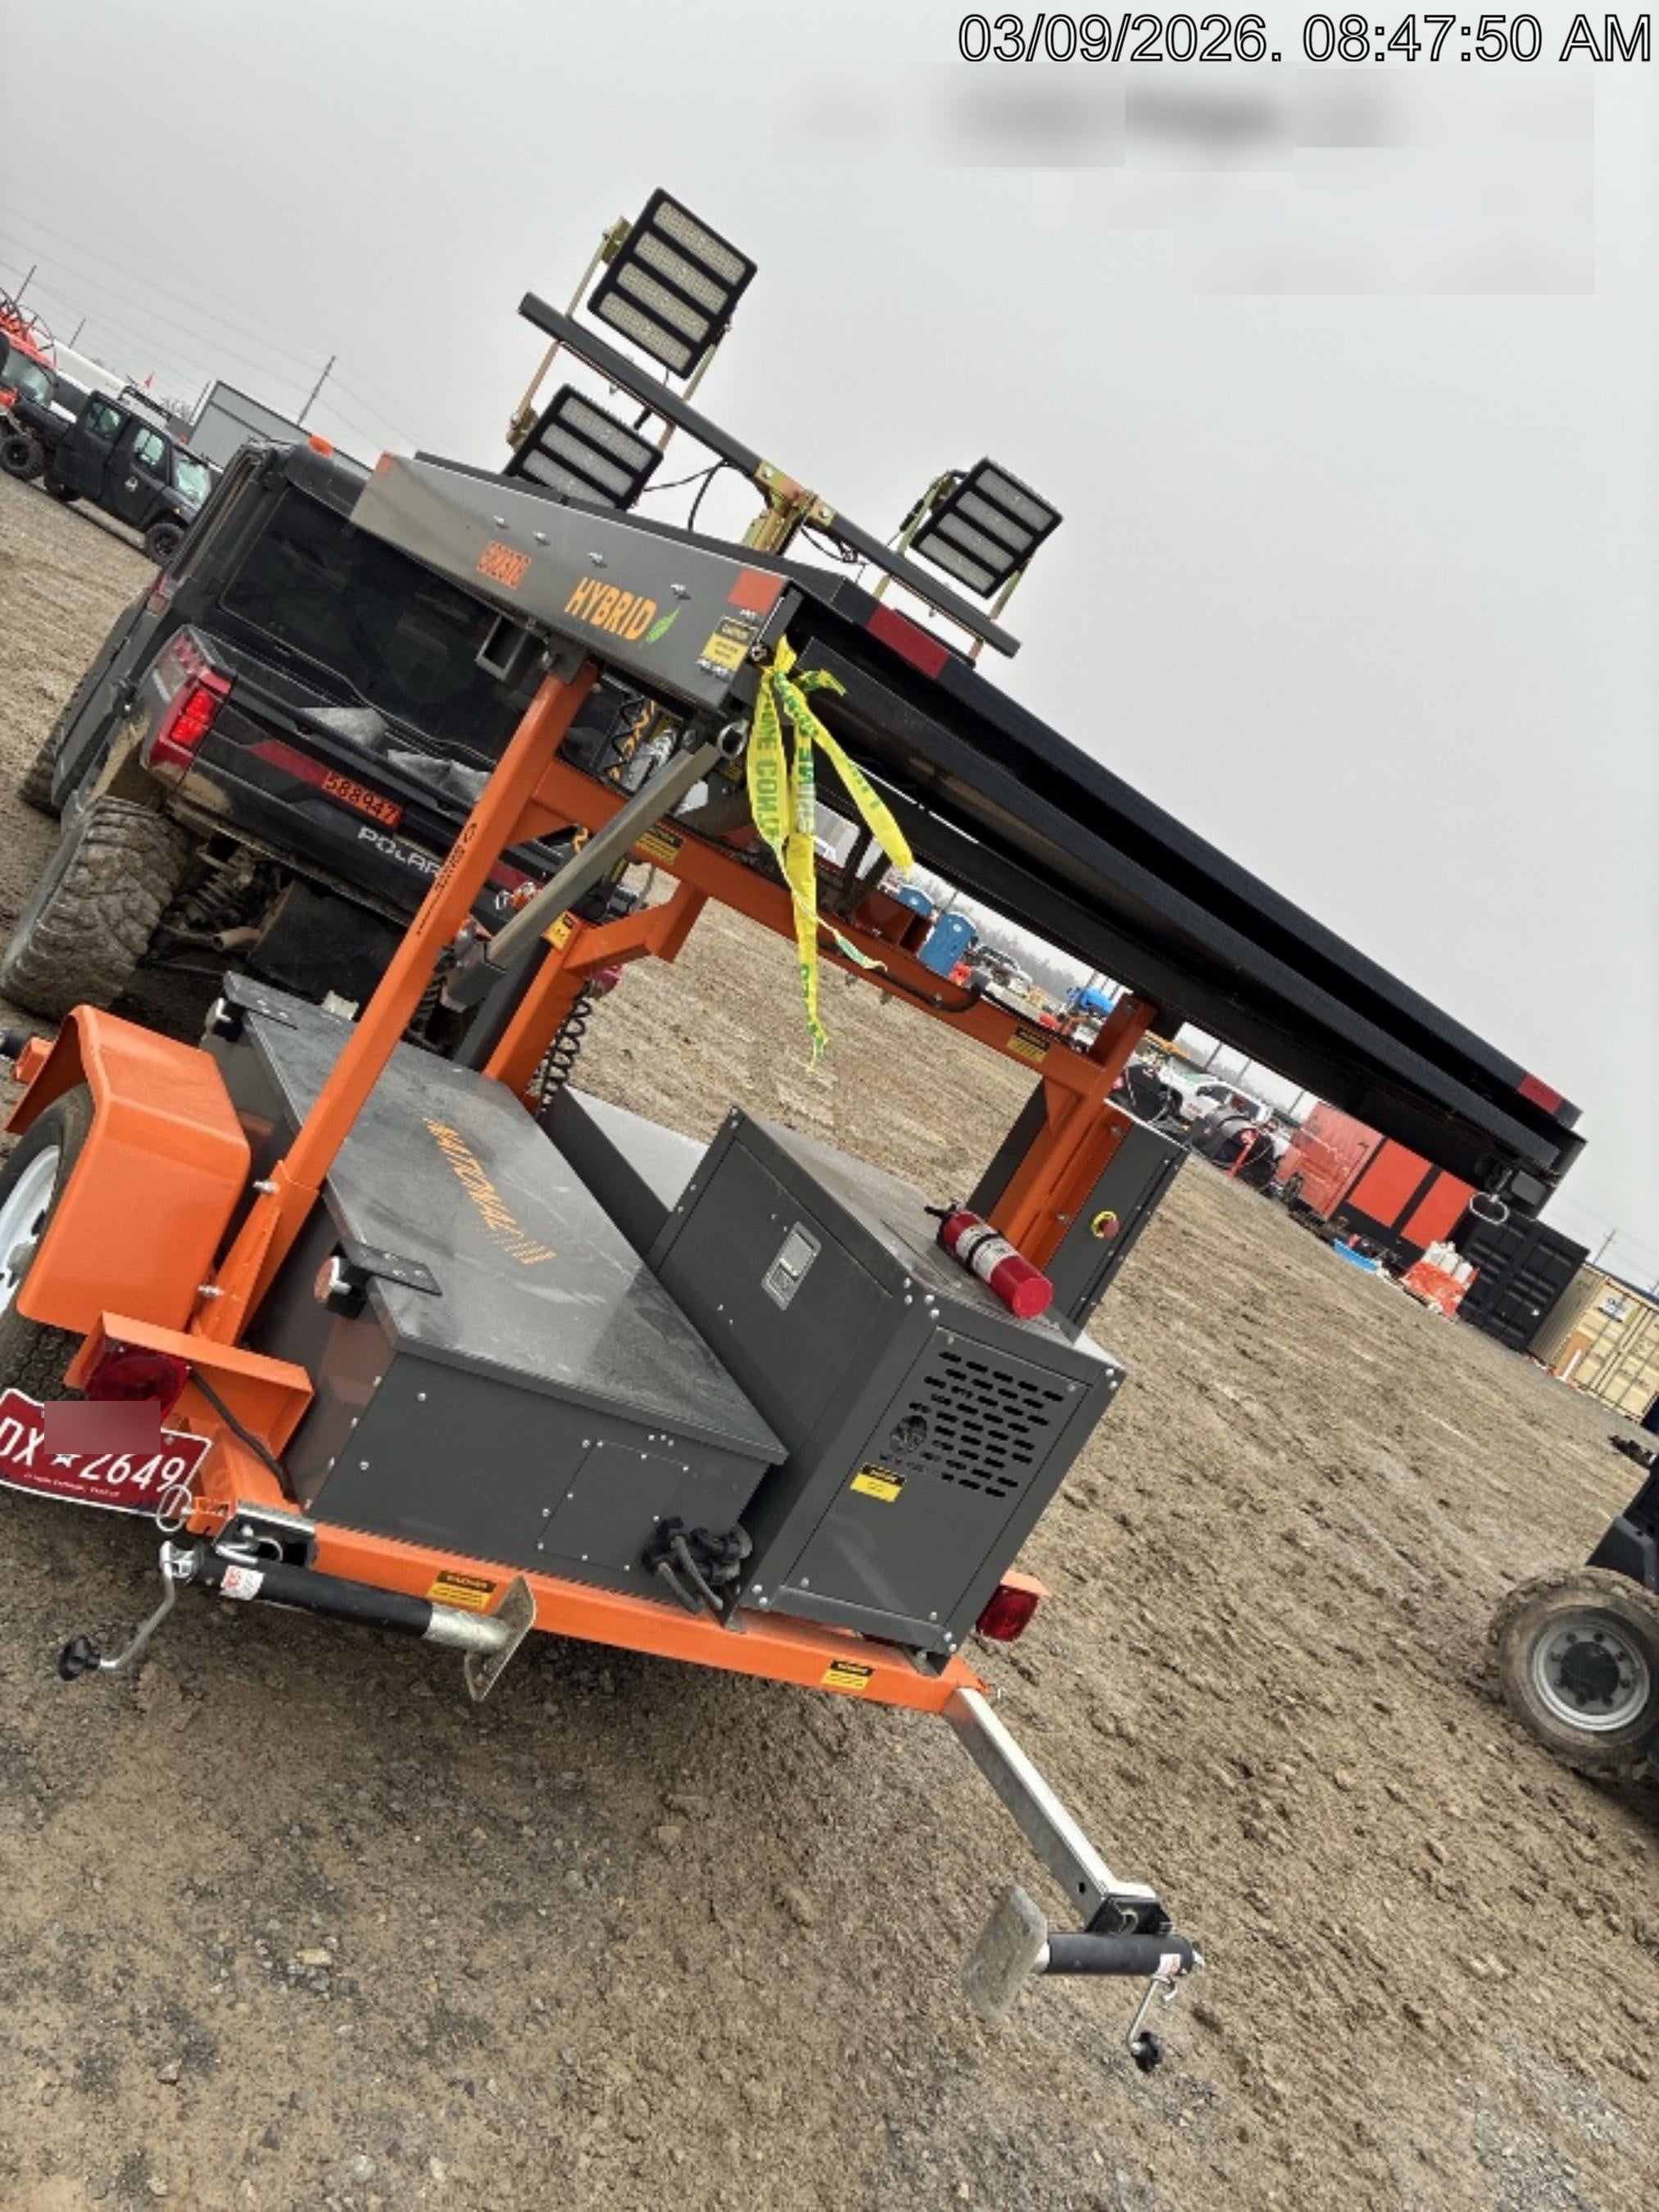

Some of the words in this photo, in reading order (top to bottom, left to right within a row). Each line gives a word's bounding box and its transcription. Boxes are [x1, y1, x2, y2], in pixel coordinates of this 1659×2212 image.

[564, 577, 657, 640] HYBRID
[325, 773, 397, 819] 588947
[79, 1453, 186, 1492] 2649
